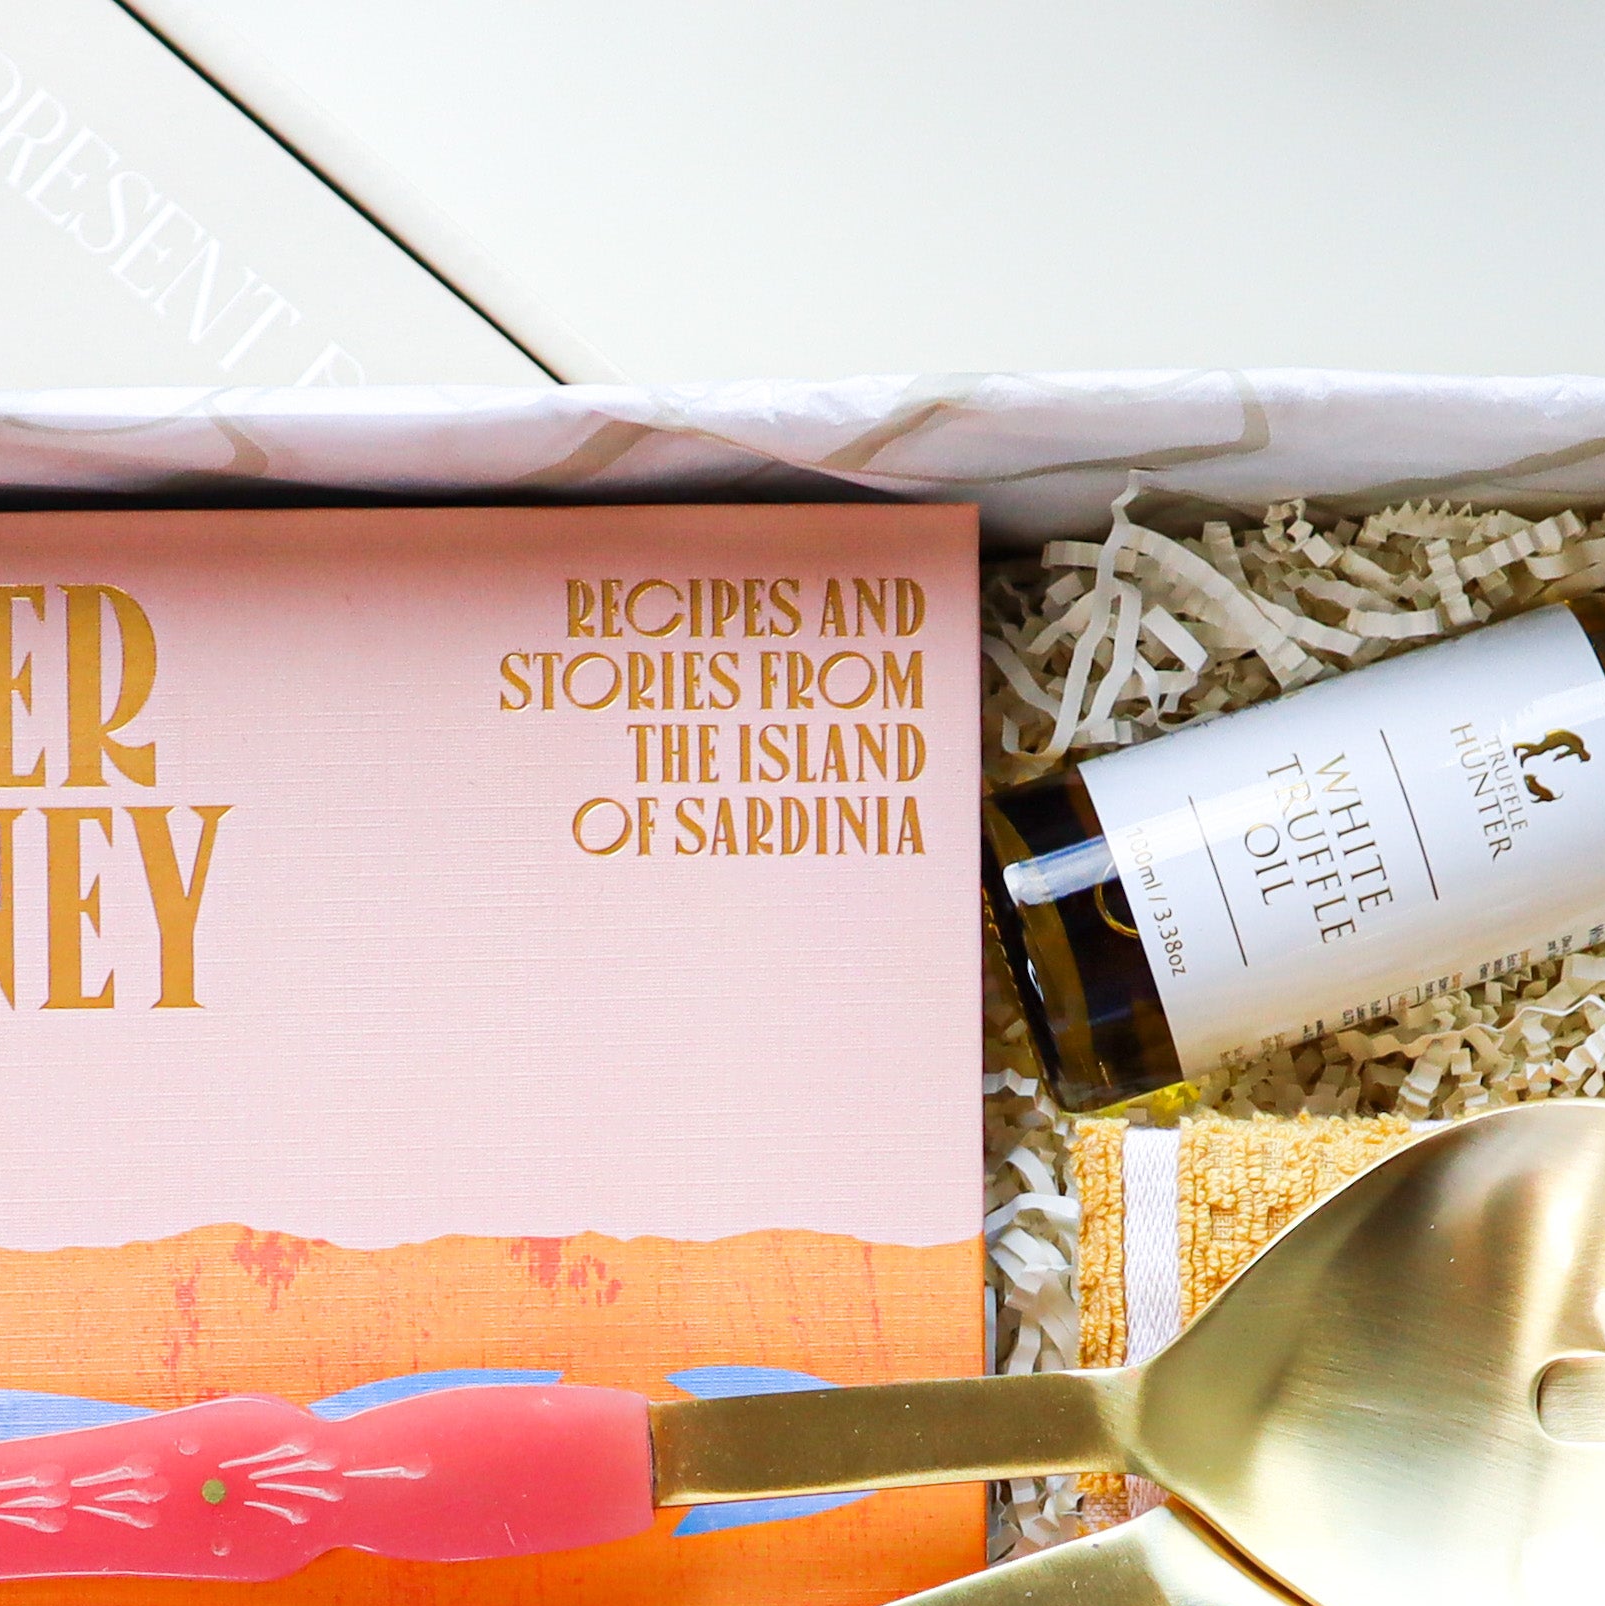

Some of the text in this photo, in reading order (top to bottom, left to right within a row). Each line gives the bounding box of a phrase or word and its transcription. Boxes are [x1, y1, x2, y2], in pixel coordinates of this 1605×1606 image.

[566, 577, 926, 639] RECIPES AND
[500, 651, 924, 711] STORIES FROM
[627, 724, 926, 783] THE ISLAND
[1484, 734, 1528, 832] TRUFFLE
[572, 796, 926, 856] OF SARDINIA
[1450, 722, 1512, 862] HUNTER
[1243, 823, 1295, 906] OIL
[1267, 752, 1356, 944] TRUFFLE
[1316, 752, 1394, 912] WHITE
[1153, 907, 1186, 977] 3.38oz
